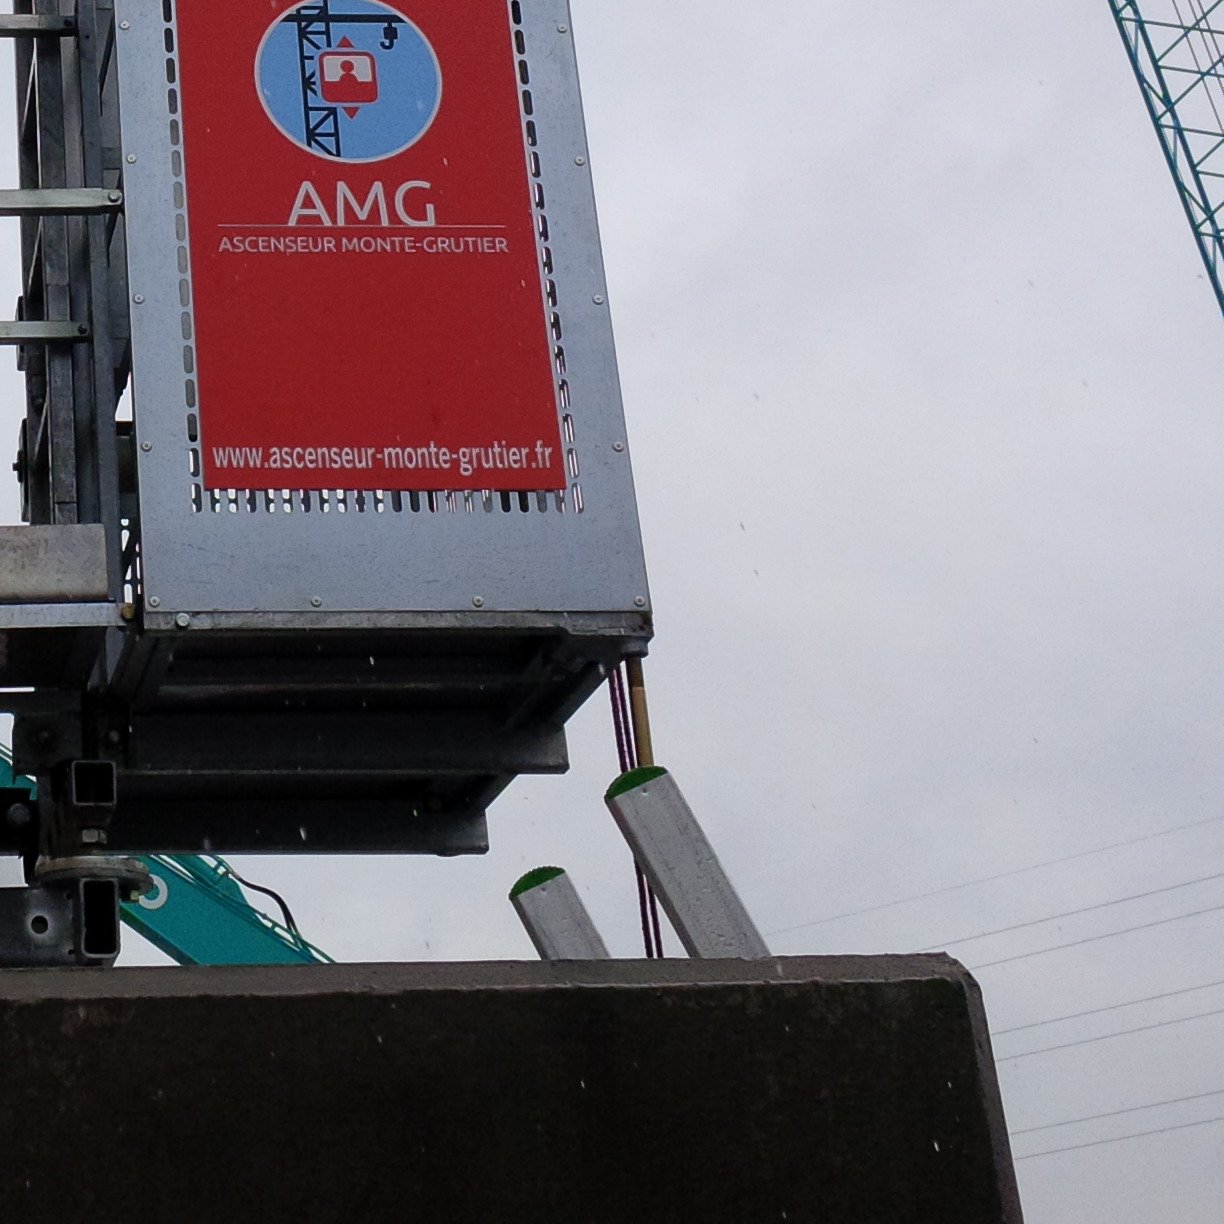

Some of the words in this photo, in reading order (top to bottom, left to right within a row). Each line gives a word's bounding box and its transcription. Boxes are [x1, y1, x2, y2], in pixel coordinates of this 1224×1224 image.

[287, 180, 437, 227] AMG
[218, 235, 337, 253] ASCENSEUR
[341, 236, 510, 254] MONTE-GRUTIER
[211, 439, 554, 476] www.ascenseur-monte-grutier.fr
